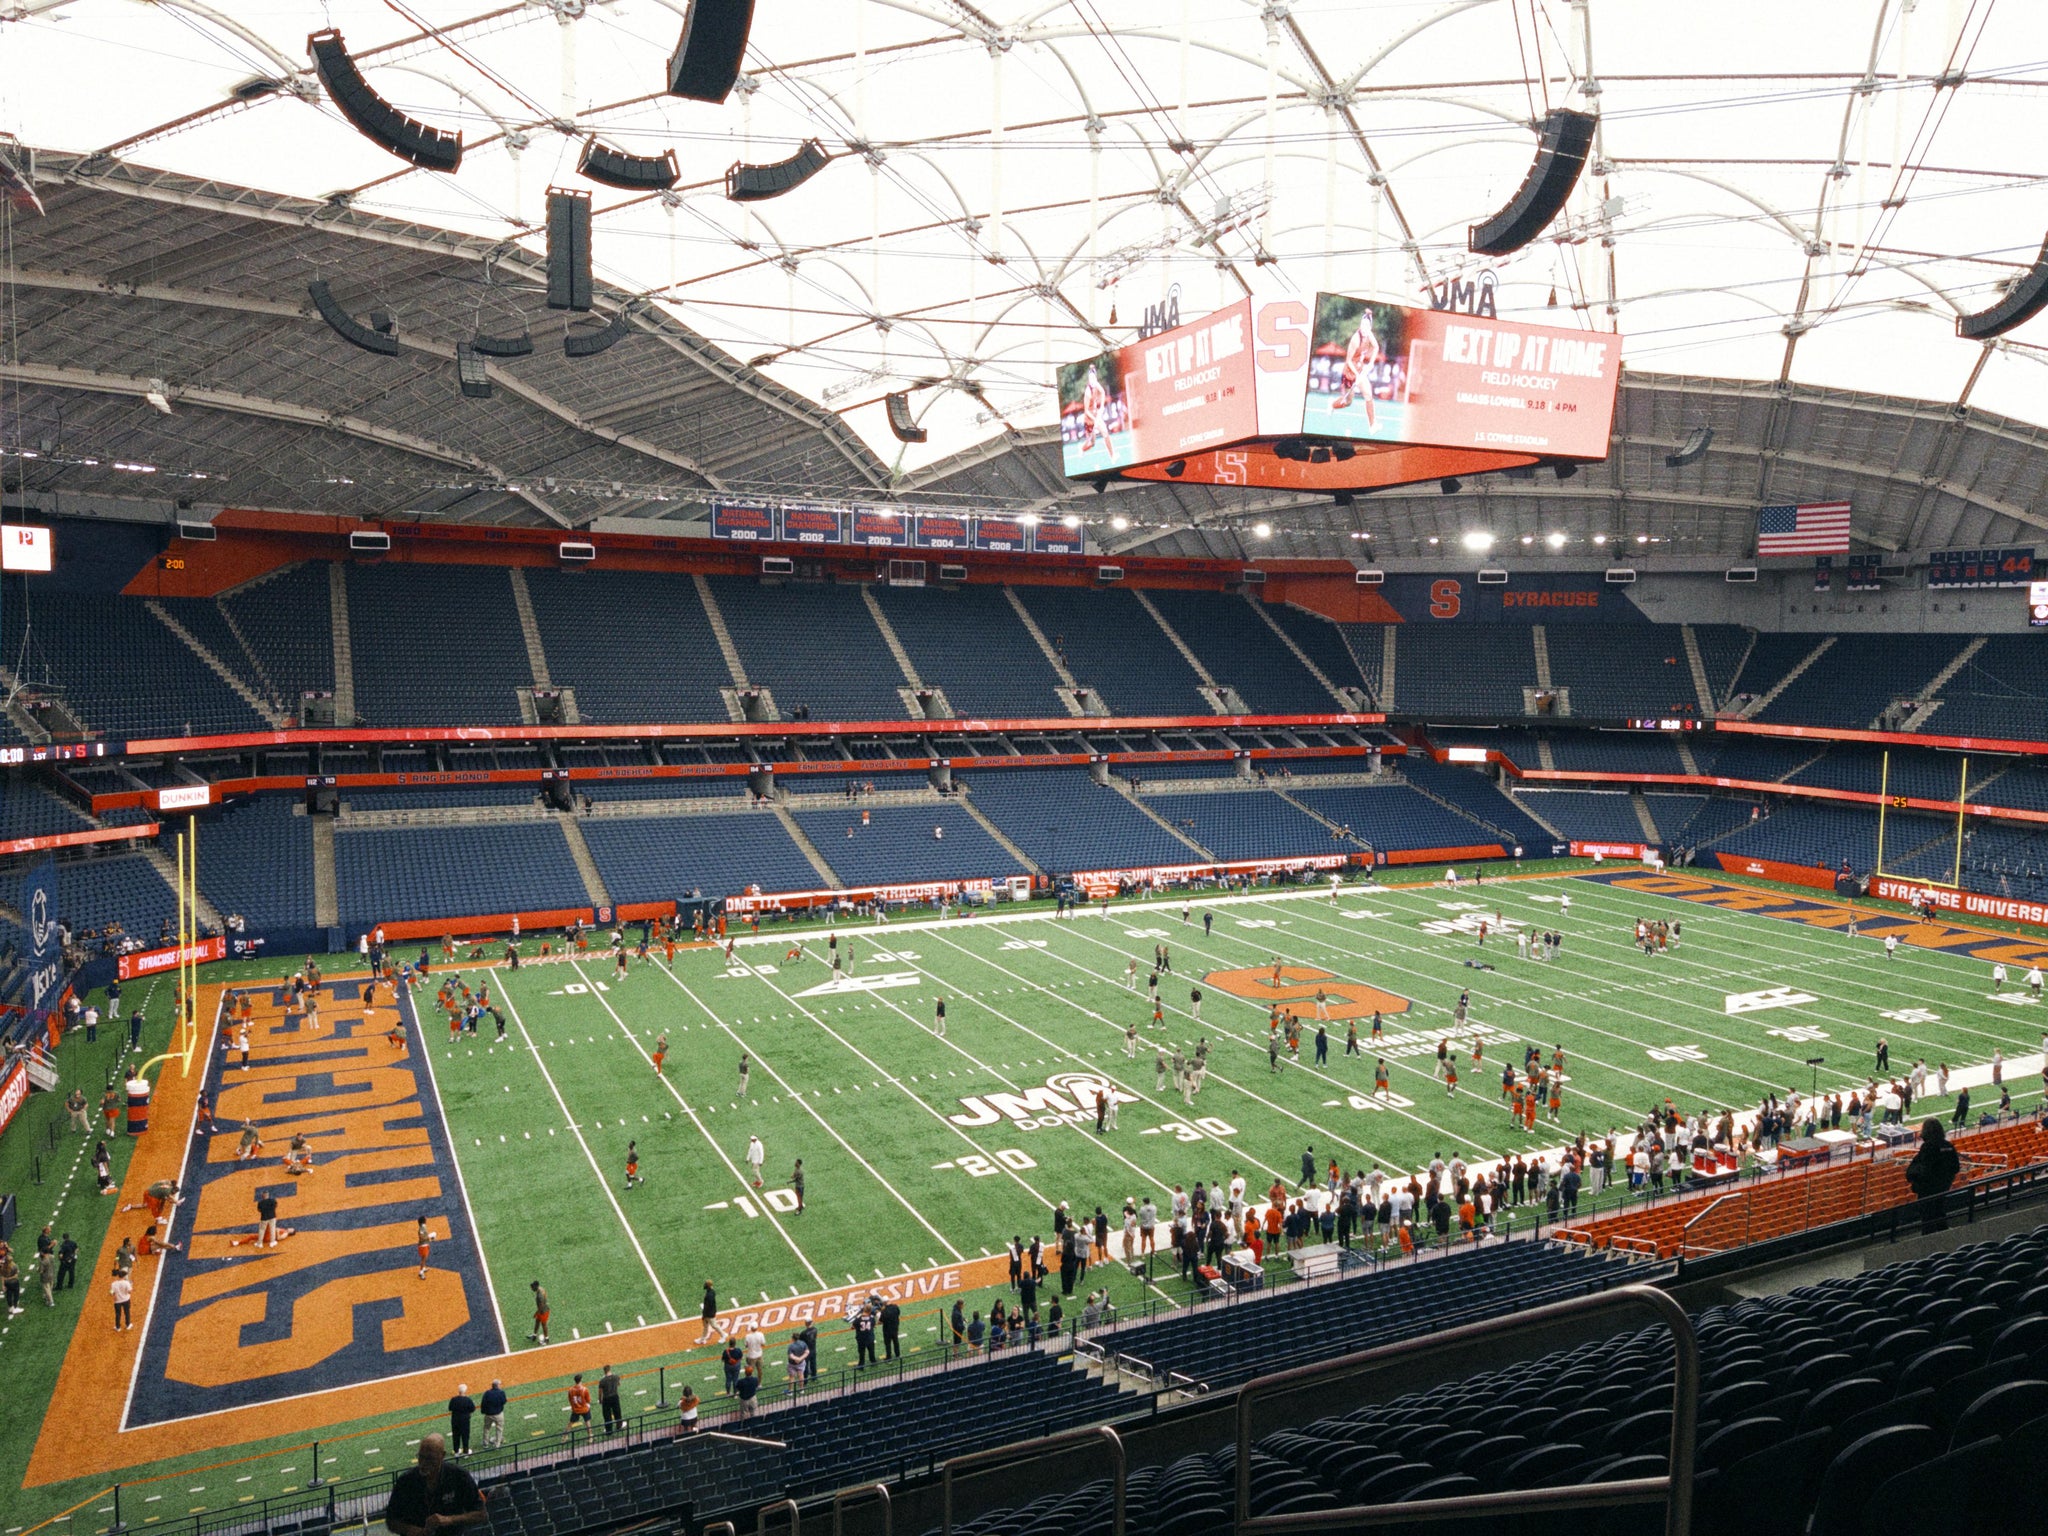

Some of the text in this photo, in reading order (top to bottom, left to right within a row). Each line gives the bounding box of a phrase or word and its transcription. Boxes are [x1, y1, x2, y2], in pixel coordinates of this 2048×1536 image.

[1430, 278, 1497, 319] JMA
[1138, 296, 1180, 340] JMA
[1257, 301, 1309, 373] S
[1145, 341, 1176, 384] NEXT
[1177, 334, 1194, 374] UP
[1195, 327, 1210, 367] AT
[1442, 324, 1607, 378] NEXT UP AT HOME
[1174, 366, 1221, 392] FIELD HOCKEY
[1481, 370, 1559, 391] FIELD HOCKEY
[1226, 386, 1235, 397] PM
[1456, 392, 1577, 413] UMASS LOWELL 9.18 4 PM
[1487, 432, 1513, 444] COYNE
[1513, 434, 1549, 446] STADIUM
[722, 509, 765, 519] NATIONAL
[791, 512, 833, 522] NATIONAL
[717, 517, 770, 528] CHAMPIONS
[786, 520, 837, 531] CHAMPIONS
[859, 516, 899, 525] NATIONAL
[923, 519, 962, 529] NATIONAL
[982, 522, 1019, 531] NATIONAL
[731, 530, 757, 540] 2000
[856, 524, 904, 535] CHAMPIONS
[919, 527, 966, 537] CHAMPIONS
[979, 530, 1023, 540] CHAMPIONS
[1040, 525, 1076, 535] NATIONAL
[799, 533, 824, 543] 2002
[868, 536, 892, 546] 2003
[931, 538, 954, 548] 2004
[1037, 533, 1080, 543] CHAMPIONS
[1048, 544, 1069, 554] 2009
[165, 558, 185, 570] 2:00
[2002, 556, 2031, 573] 44
[1430, 579, 1461, 619] S
[1503, 591, 1599, 607] SYRACUSE
[1685, 721, 1692, 729] S
[33, 752, 46, 760] 1ST
[76, 744, 86, 758] S
[822, 762, 842, 770] DAVIS
[884, 760, 907, 768] LITTLE
[598, 767, 653, 777] JIM BOEHEIM
[679, 766, 725, 775] JIM BROWN
[412, 774, 436, 783] RING
[440, 773, 451, 782] OF
[455, 772, 489, 781] HONOR
[161, 790, 207, 805] DUNKIN'
[1893, 796, 1907, 808] 25
[1610, 846, 1634, 855] FOOTBALL
[599, 907, 611, 922] S
[138, 944, 209, 971] SYRACUSE FOTALL
[1202, 965, 1413, 1020] S
[1879, 1008, 1942, 1024] 20
[1766, 1024, 1831, 1043] 30
[1646, 1044, 1708, 1063] 40
[949, 1080, 1140, 1126] JMA
[1348, 1091, 1415, 1112] 40
[1166, 1116, 1238, 1142] 30
[956, 1149, 1038, 1178] 20
[165, 980, 470, 1388] SYRACUSE
[733, 1188, 801, 1218] 10
[707, 1270, 961, 1338] PROGRESSIVE
[859, 1321, 871, 1332] 34
